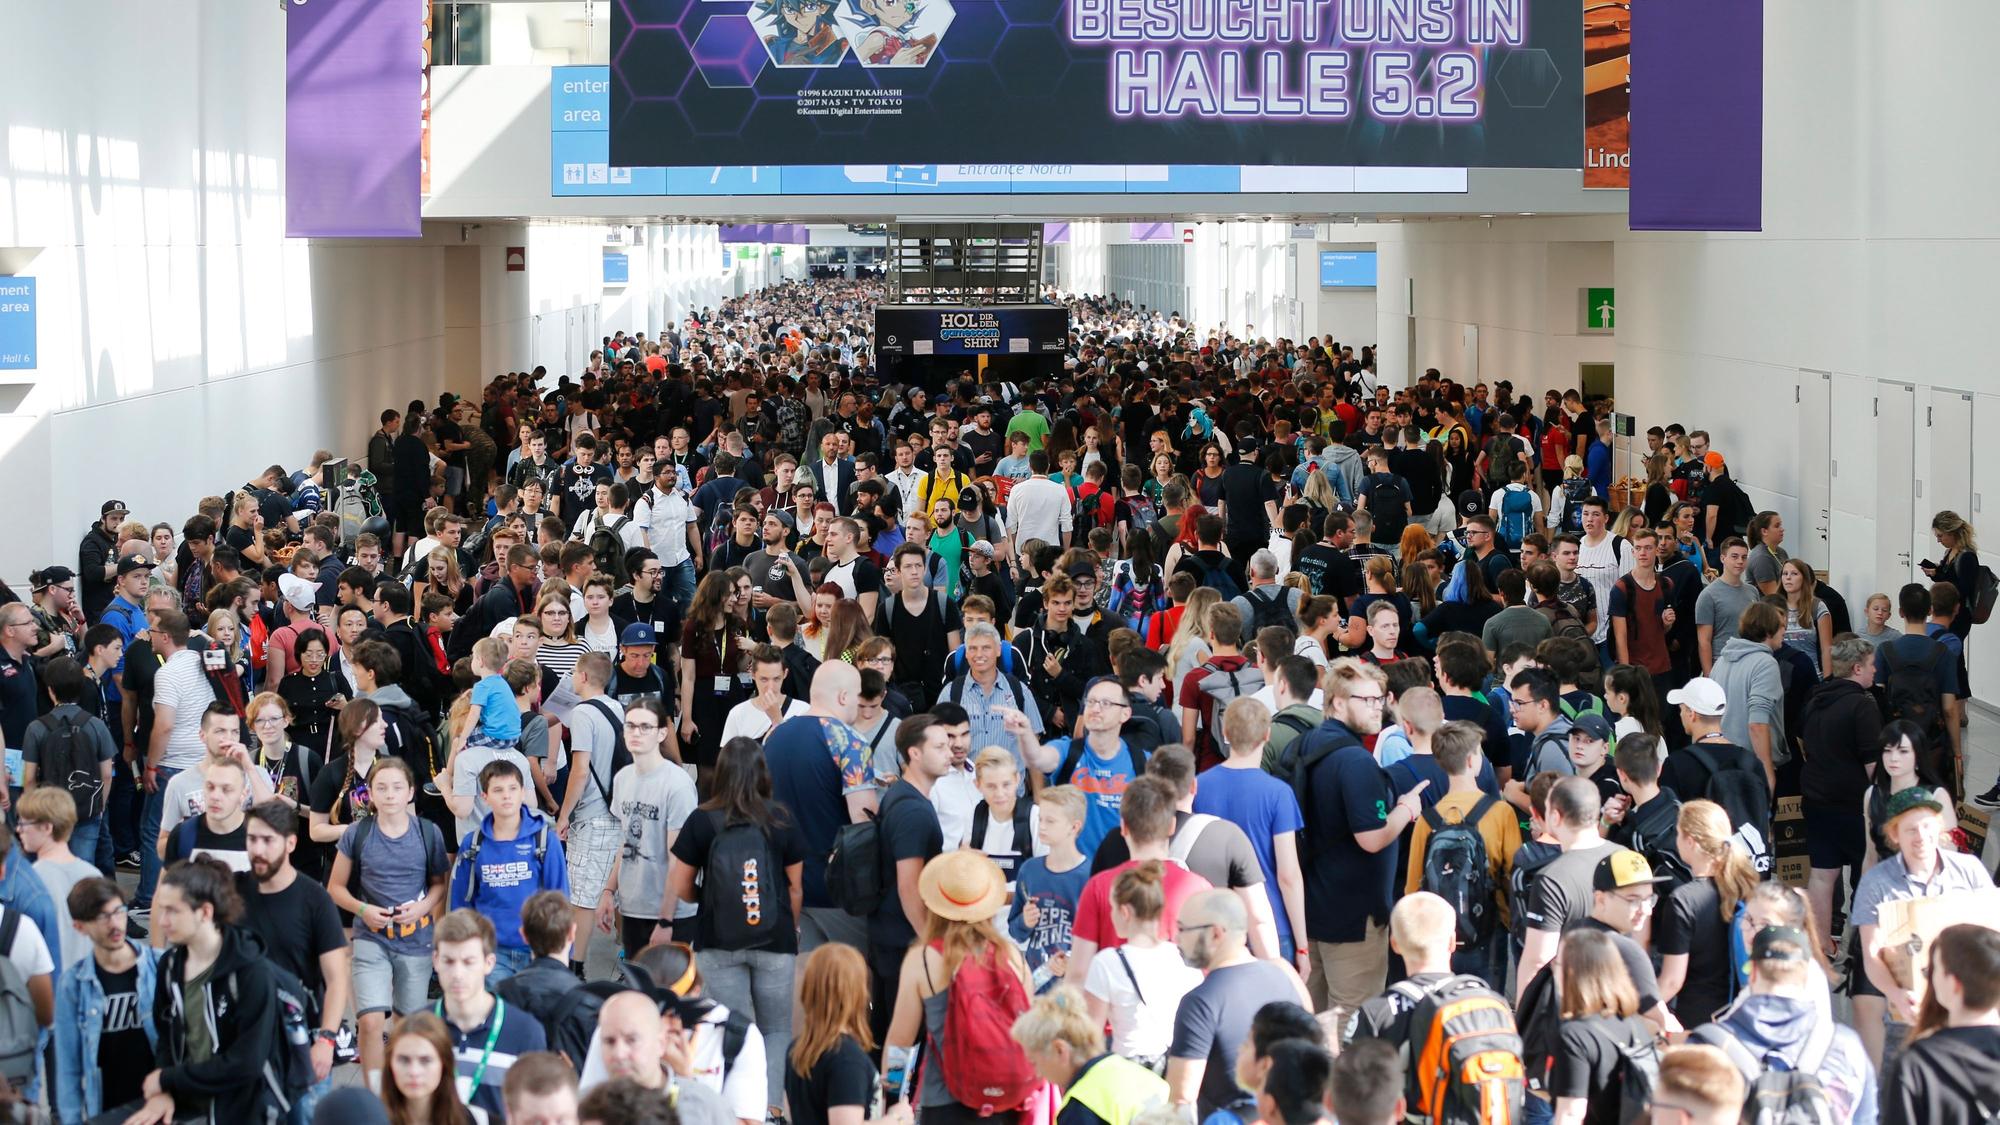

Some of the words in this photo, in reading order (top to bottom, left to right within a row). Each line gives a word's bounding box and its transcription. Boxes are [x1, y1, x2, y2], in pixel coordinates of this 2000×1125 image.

[1072, 0, 1331, 41] BESUCHT
[1341, 0, 1454, 43] UNS
[1467, 0, 1523, 44] IN
[1114, 50, 1349, 117] HALLE
[1371, 52, 1479, 118] 5.2
[821, 89, 853, 97] KAZUKI
[854, 89, 902, 97] TAKAHASHI
[563, 110, 601, 122] area
[830, 108, 853, 117] Digital
[958, 164, 1025, 176] Entrance
[1030, 164, 1072, 176] North
[1, 303, 30, 312] area
[940, 313, 978, 328] HOL
[979, 313, 994, 321] DIR
[979, 320, 1000, 328] DEIN
[940, 328, 1000, 341] gamescom
[964, 338, 1000, 348] SHIRT
[2, 353, 21, 363] Hall
[24, 353, 31, 362] 6
[1375, 799, 1388, 820] 3
[1038, 907, 1072, 927] EPE
